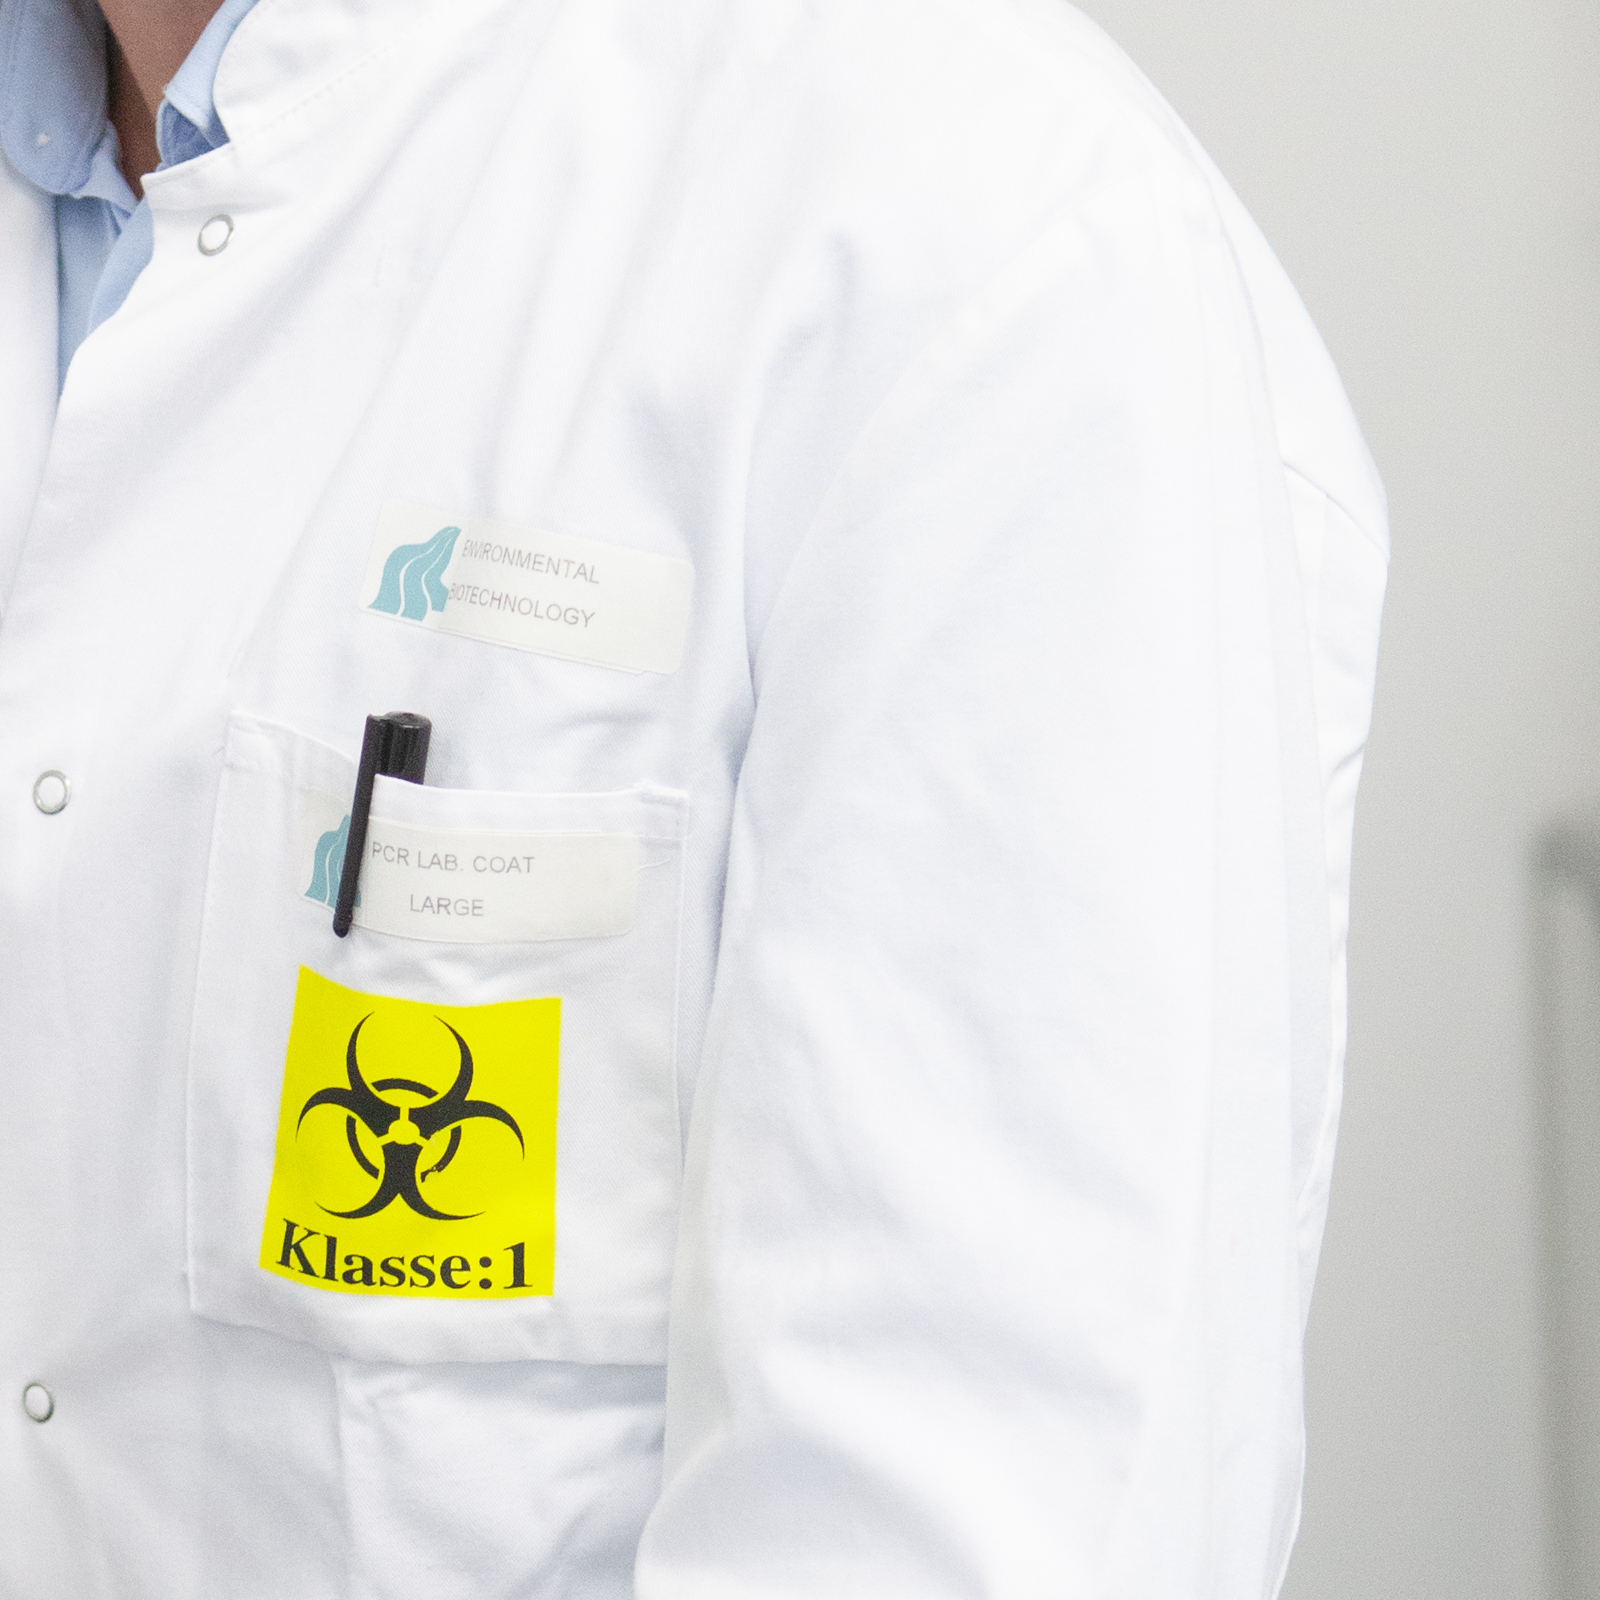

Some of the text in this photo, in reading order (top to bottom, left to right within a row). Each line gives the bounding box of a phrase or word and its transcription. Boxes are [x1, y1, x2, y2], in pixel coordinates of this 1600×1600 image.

[461, 539, 600, 585] ENVIRONMENTAL
[448, 582, 596, 628] BIOTECHNOLOGY
[371, 841, 536, 874] PCR LAB. COAT
[409, 893, 485, 917] LARGE
[275, 1217, 534, 1290] Klasse:1
